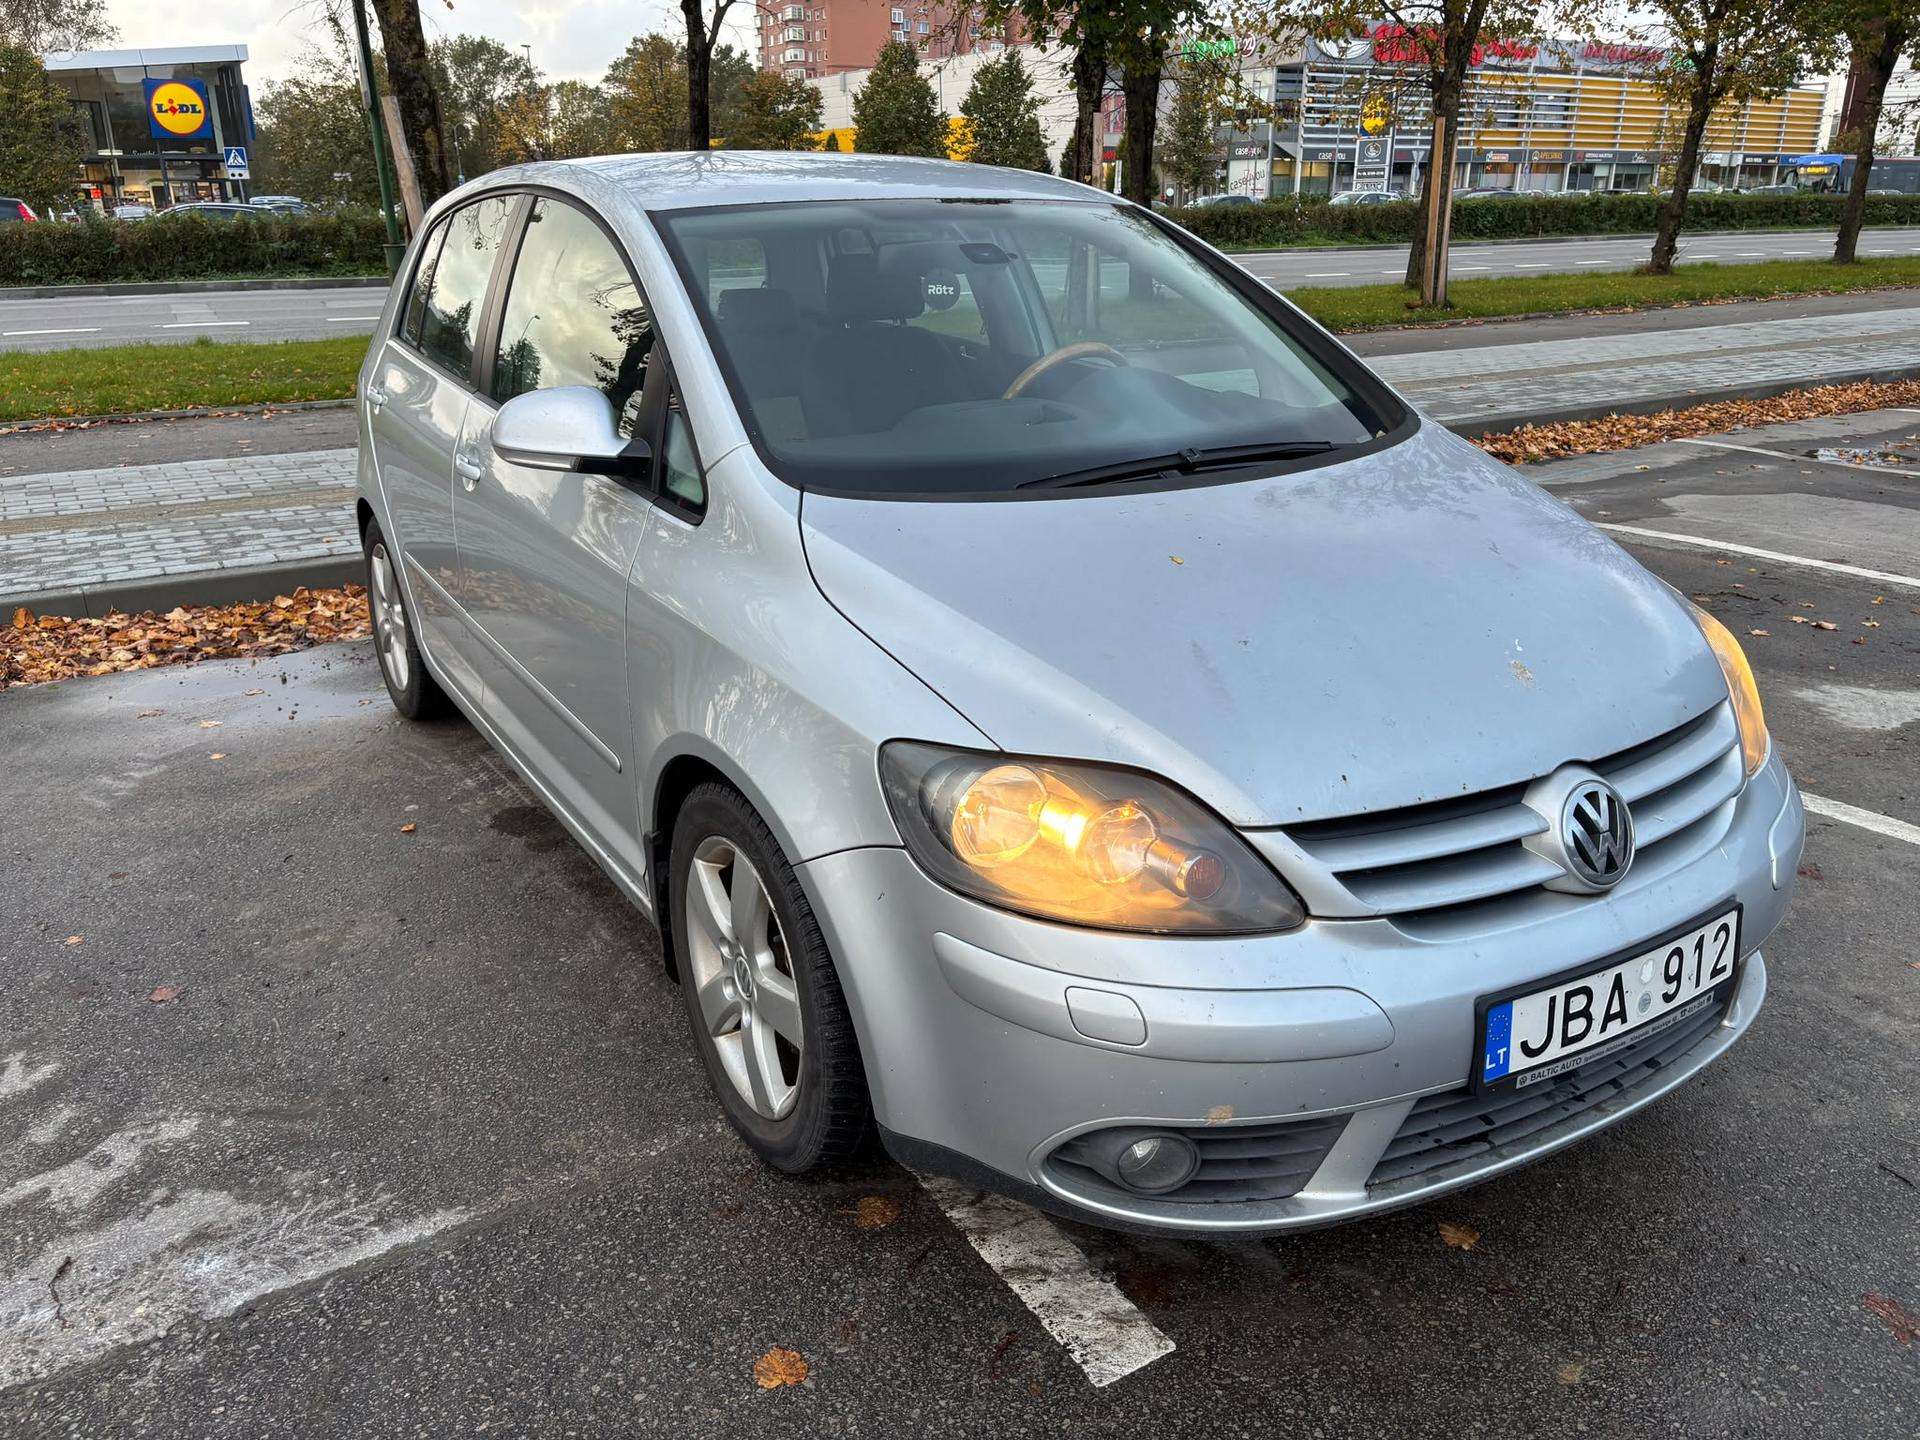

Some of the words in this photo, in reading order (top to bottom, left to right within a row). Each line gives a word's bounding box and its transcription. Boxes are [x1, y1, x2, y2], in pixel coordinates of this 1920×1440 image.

[1519, 972, 1628, 1058] JBA
[1661, 922, 1731, 1004] 912
[1485, 1047, 1507, 1070] LT
[1530, 1065, 1559, 1081] BALTIC
[1560, 1057, 1581, 1073] AUTO
